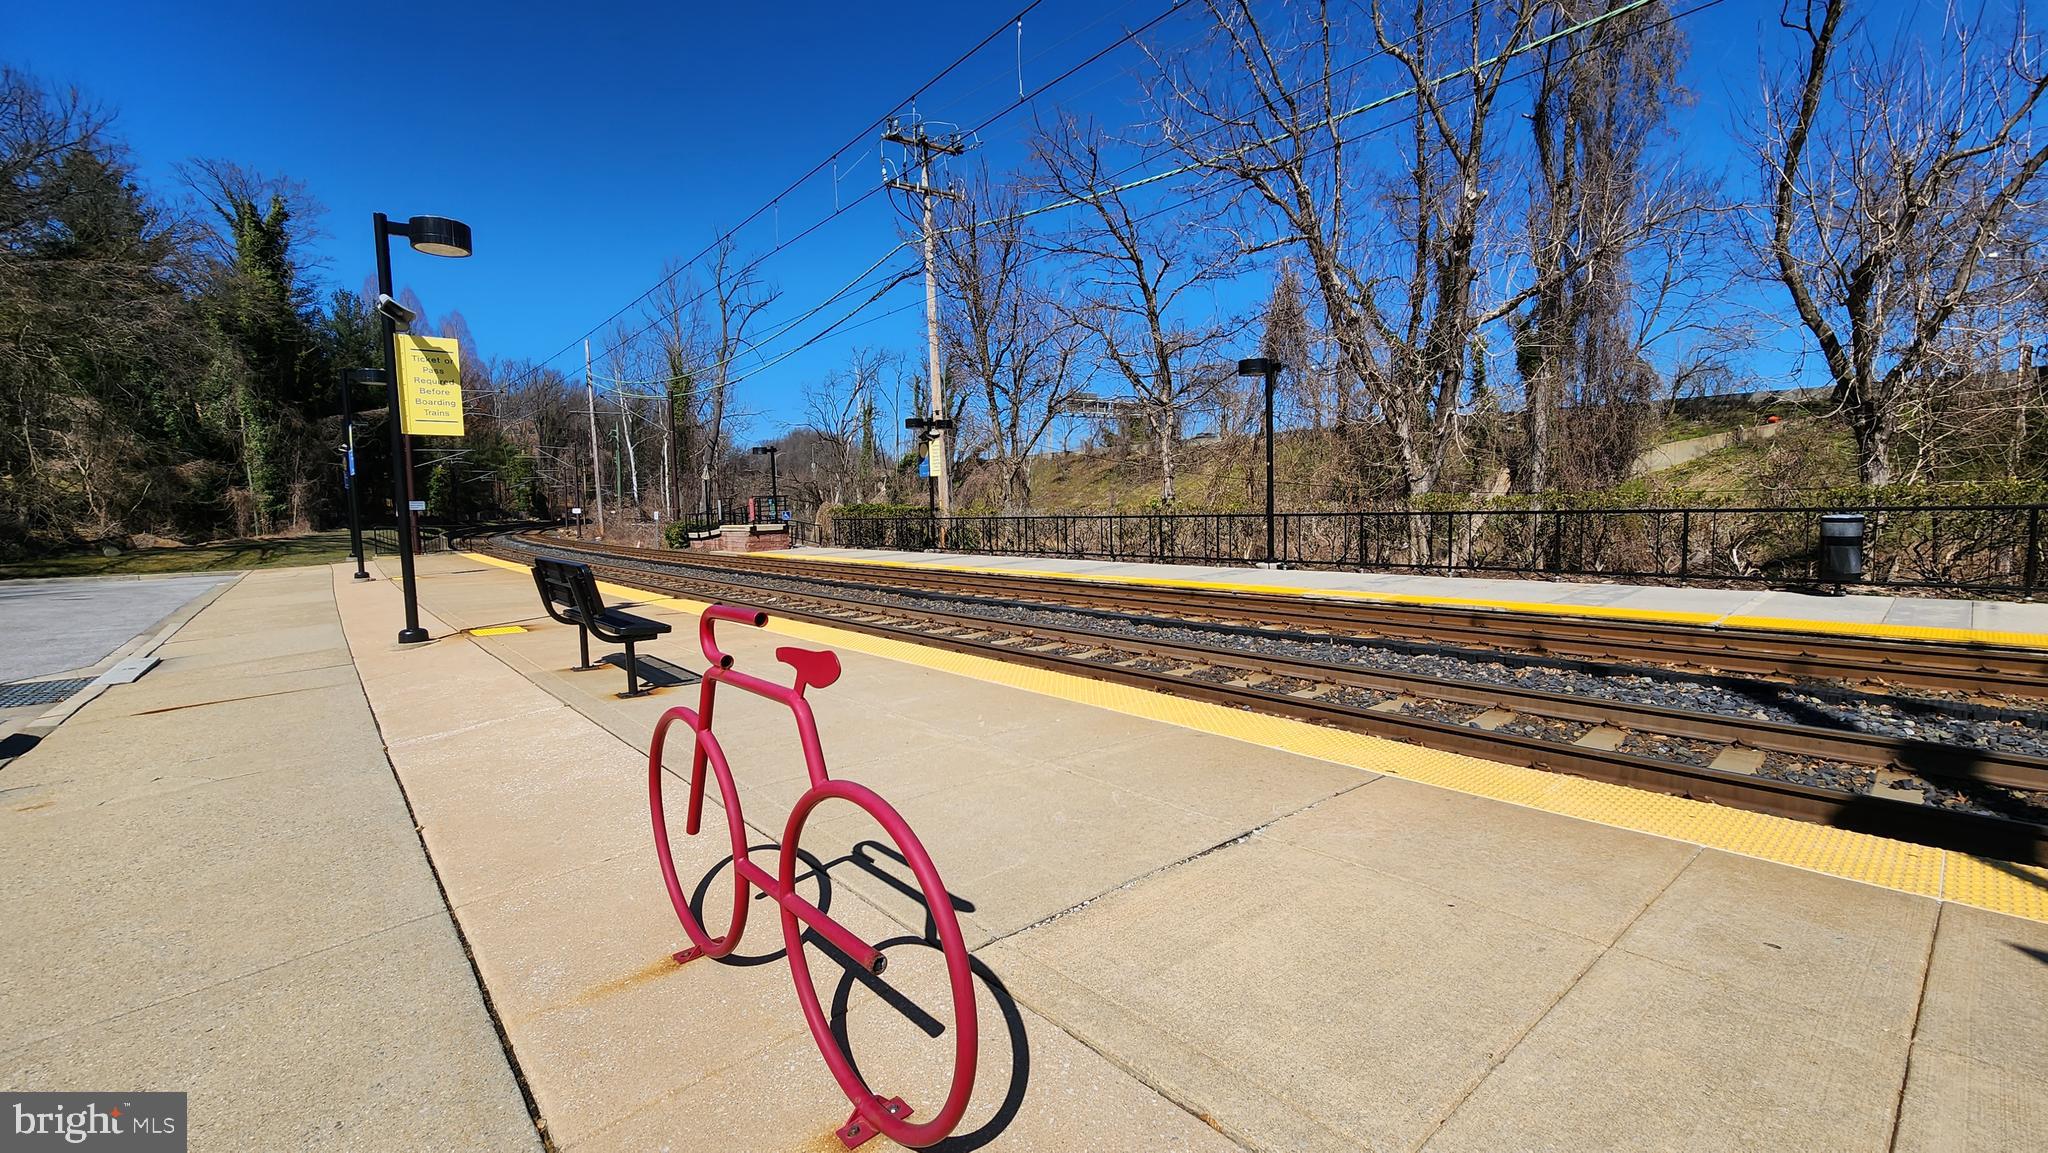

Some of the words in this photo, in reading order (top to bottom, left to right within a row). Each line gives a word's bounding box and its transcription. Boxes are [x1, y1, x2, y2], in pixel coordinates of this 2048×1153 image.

[413, 355, 441, 364] Ticket
[415, 377, 455, 385] Required
[415, 398, 456, 407] Boarding
